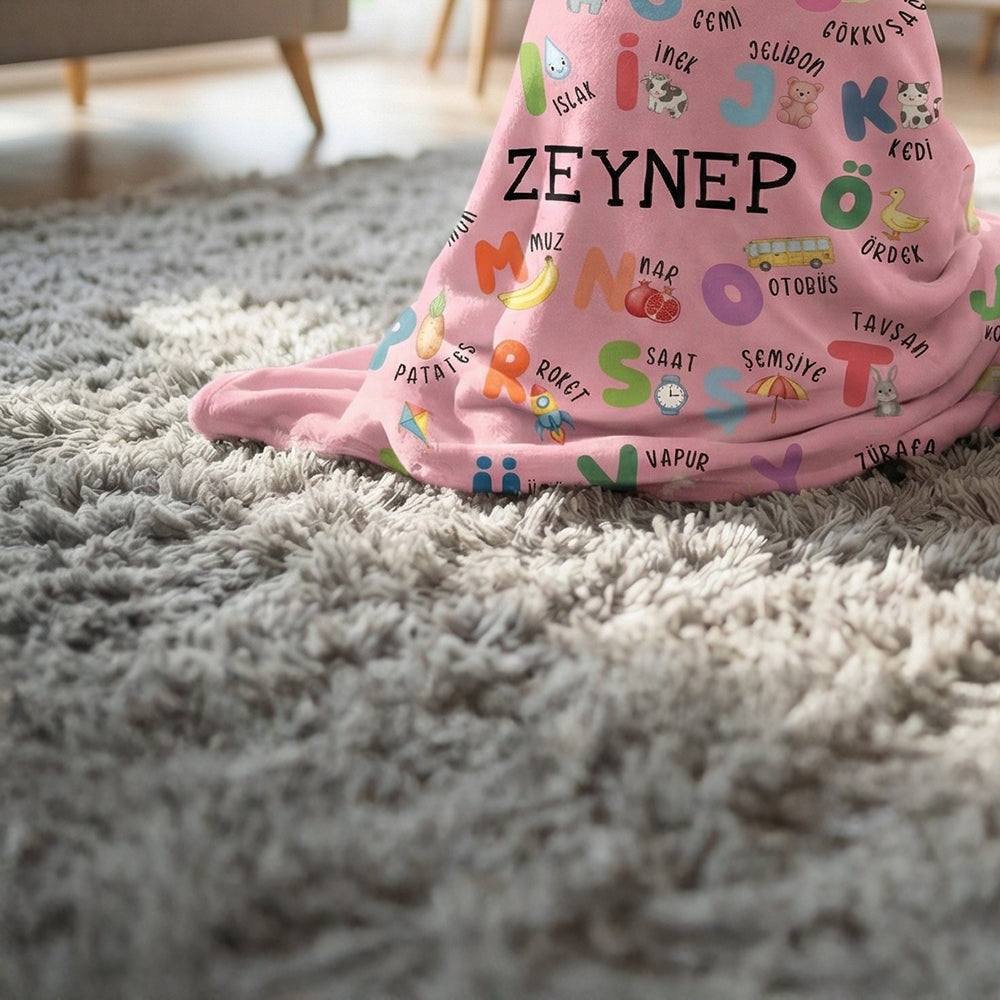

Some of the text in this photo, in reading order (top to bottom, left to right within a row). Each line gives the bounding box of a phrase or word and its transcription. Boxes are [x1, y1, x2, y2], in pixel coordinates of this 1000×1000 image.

[552, 81, 596, 116] ISLAK
[720, 63, 775, 128] J
[842, 76, 898, 141] K
[888, 138, 933, 161] KEDİ
[503, 145, 797, 214] ZEYNEP
[820, 160, 872, 230] Ö
[475, 231, 528, 294] M
[530, 232, 565, 252] MUZ
[861, 235, 924, 264] ÖRDEK
[573, 247, 637, 309] N
[640, 256, 679, 285] NAR
[702, 263, 763, 326] O
[768, 272, 839, 296] OTOBÜS
[852, 311, 930, 359] TAVŞAN
[393, 342, 476, 385] PATATES
[483, 340, 530, 404] R
[536, 359, 590, 403] ROKET
[599, 340, 651, 408] S
[646, 347, 698, 372] SAAT
[827, 341, 894, 407] T
[646, 449, 710, 472] VAPUR
